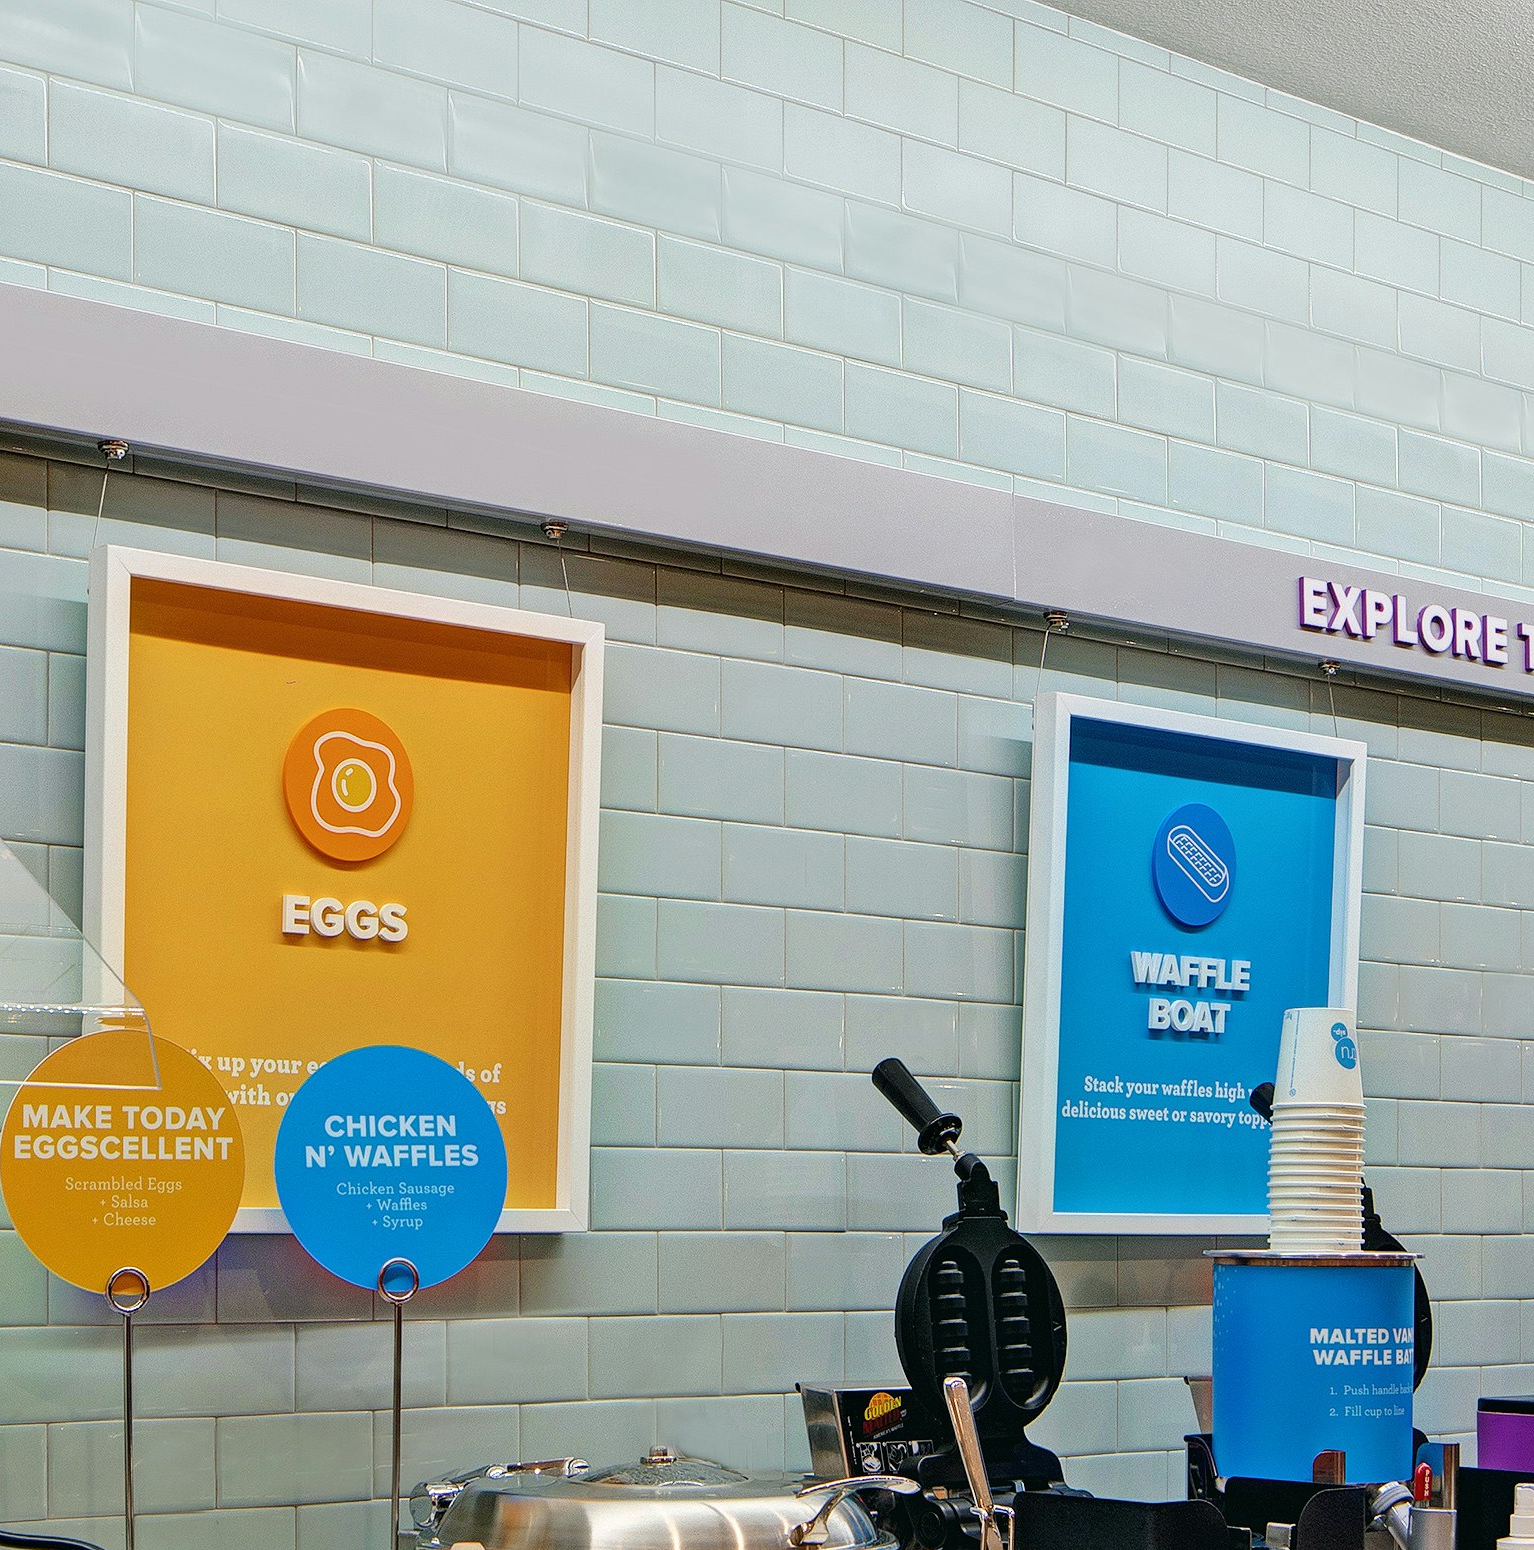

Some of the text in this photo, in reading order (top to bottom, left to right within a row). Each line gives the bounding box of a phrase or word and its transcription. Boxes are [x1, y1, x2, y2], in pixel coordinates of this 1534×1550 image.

[1299, 576, 1508, 666] EXPLORE
[281, 893, 410, 943] EGGS
[1129, 950, 1252, 993] WAFFLE
[1147, 999, 1232, 1035] BOAT
[217, 1058, 245, 1077] up
[249, 1058, 303, 1078] your
[480, 1063, 503, 1084] of
[226, 1084, 271, 1106] with
[1084, 1075, 1246, 1103] Stack your waffles high
[21, 1104, 227, 1132] MAKE TODAY
[324, 1114, 457, 1139] CHICKEN
[1061, 1099, 1272, 1129] delicious sweet or savory topp
[13, 1135, 234, 1162] EGGSCELLENT
[343, 1143, 479, 1168] WAFFLES
[64, 1176, 183, 1195] Scrambled Eggs
[335, 1181, 455, 1199] Chicken Sausage
[111, 1194, 149, 1209] Salsa
[375, 1197, 428, 1212] Waffles
[103, 1212, 157, 1227] Cheese
[381, 1215, 424, 1231] Syrup
[1309, 1327, 1414, 1345] MALTED VAN
[1312, 1348, 1414, 1366] WAFFLE BAT
[1329, 1386, 1338, 1396] 1.
[1343, 1385, 1370, 1396] Push
[1371, 1383, 1399, 1396] handle
[864, 1395, 902, 1421] GOLDEN
[1329, 1405, 1405, 1419] 2. Fill cup to line
